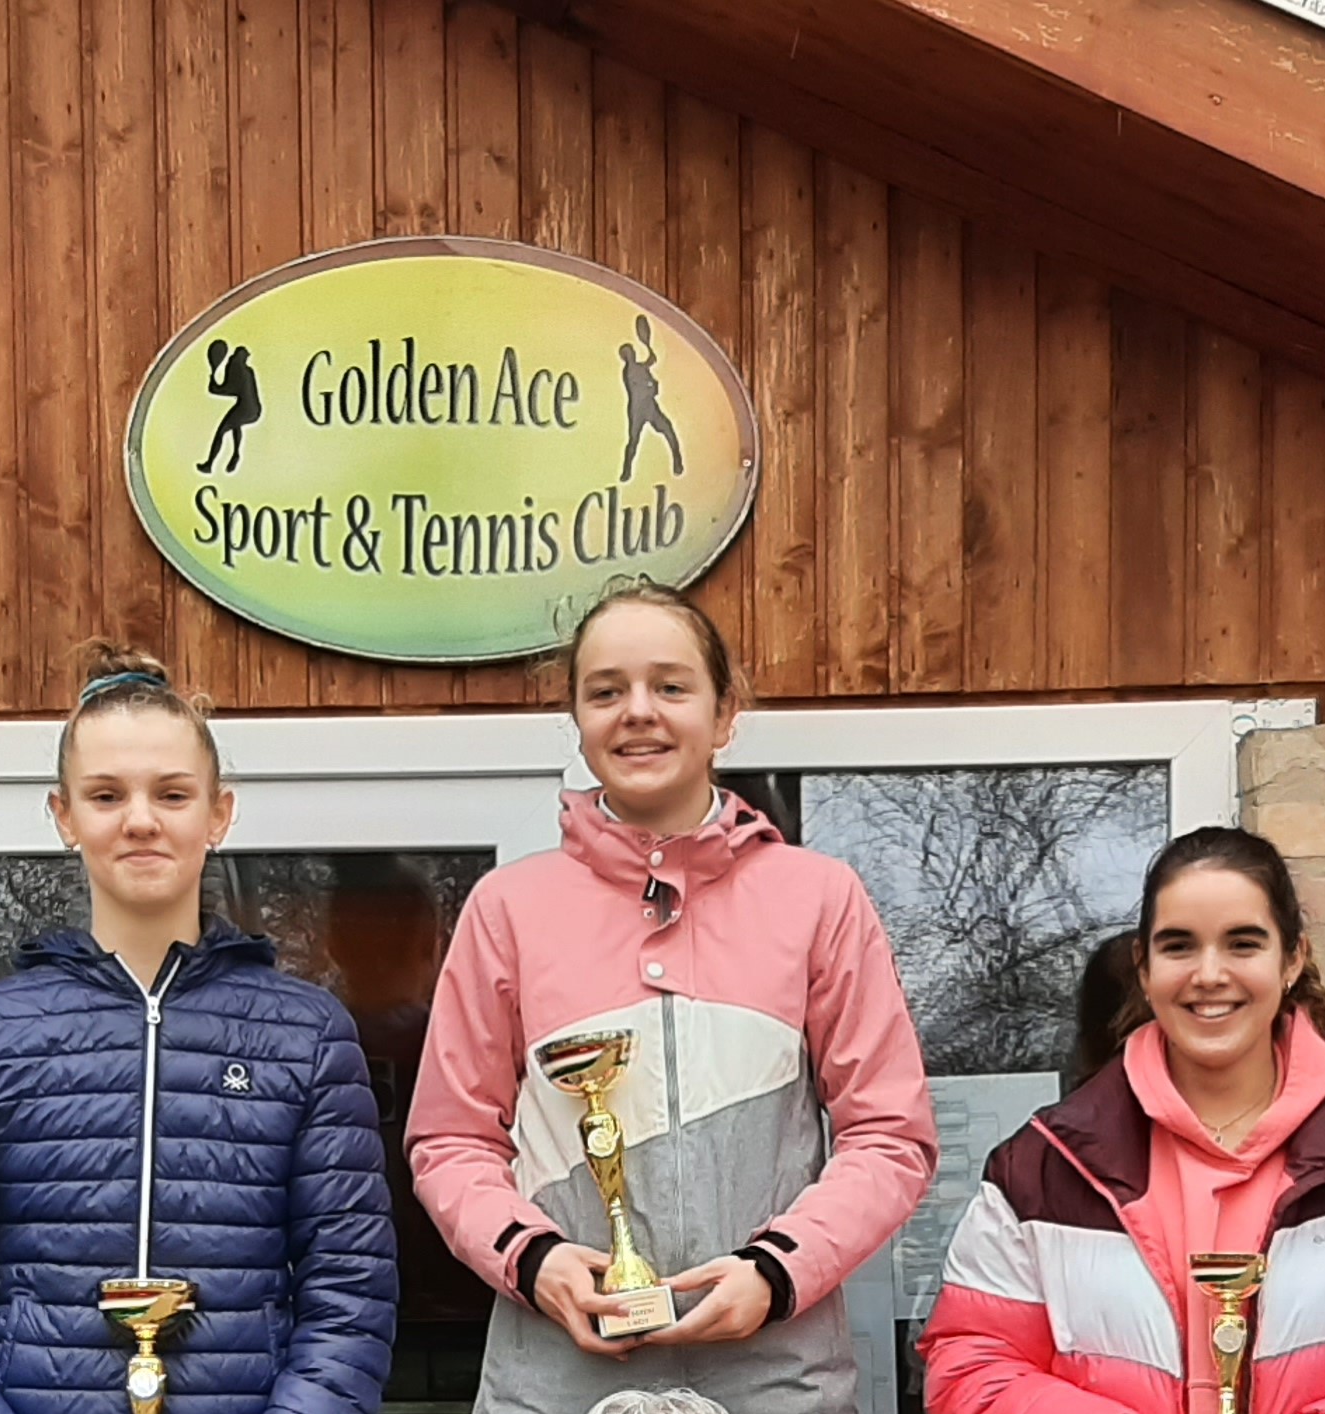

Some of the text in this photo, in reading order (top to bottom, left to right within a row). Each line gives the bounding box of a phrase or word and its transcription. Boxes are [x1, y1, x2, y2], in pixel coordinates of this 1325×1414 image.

[301, 337, 579, 429] Golden Ace
[193, 484, 684, 575] Sport & Tennis Club
